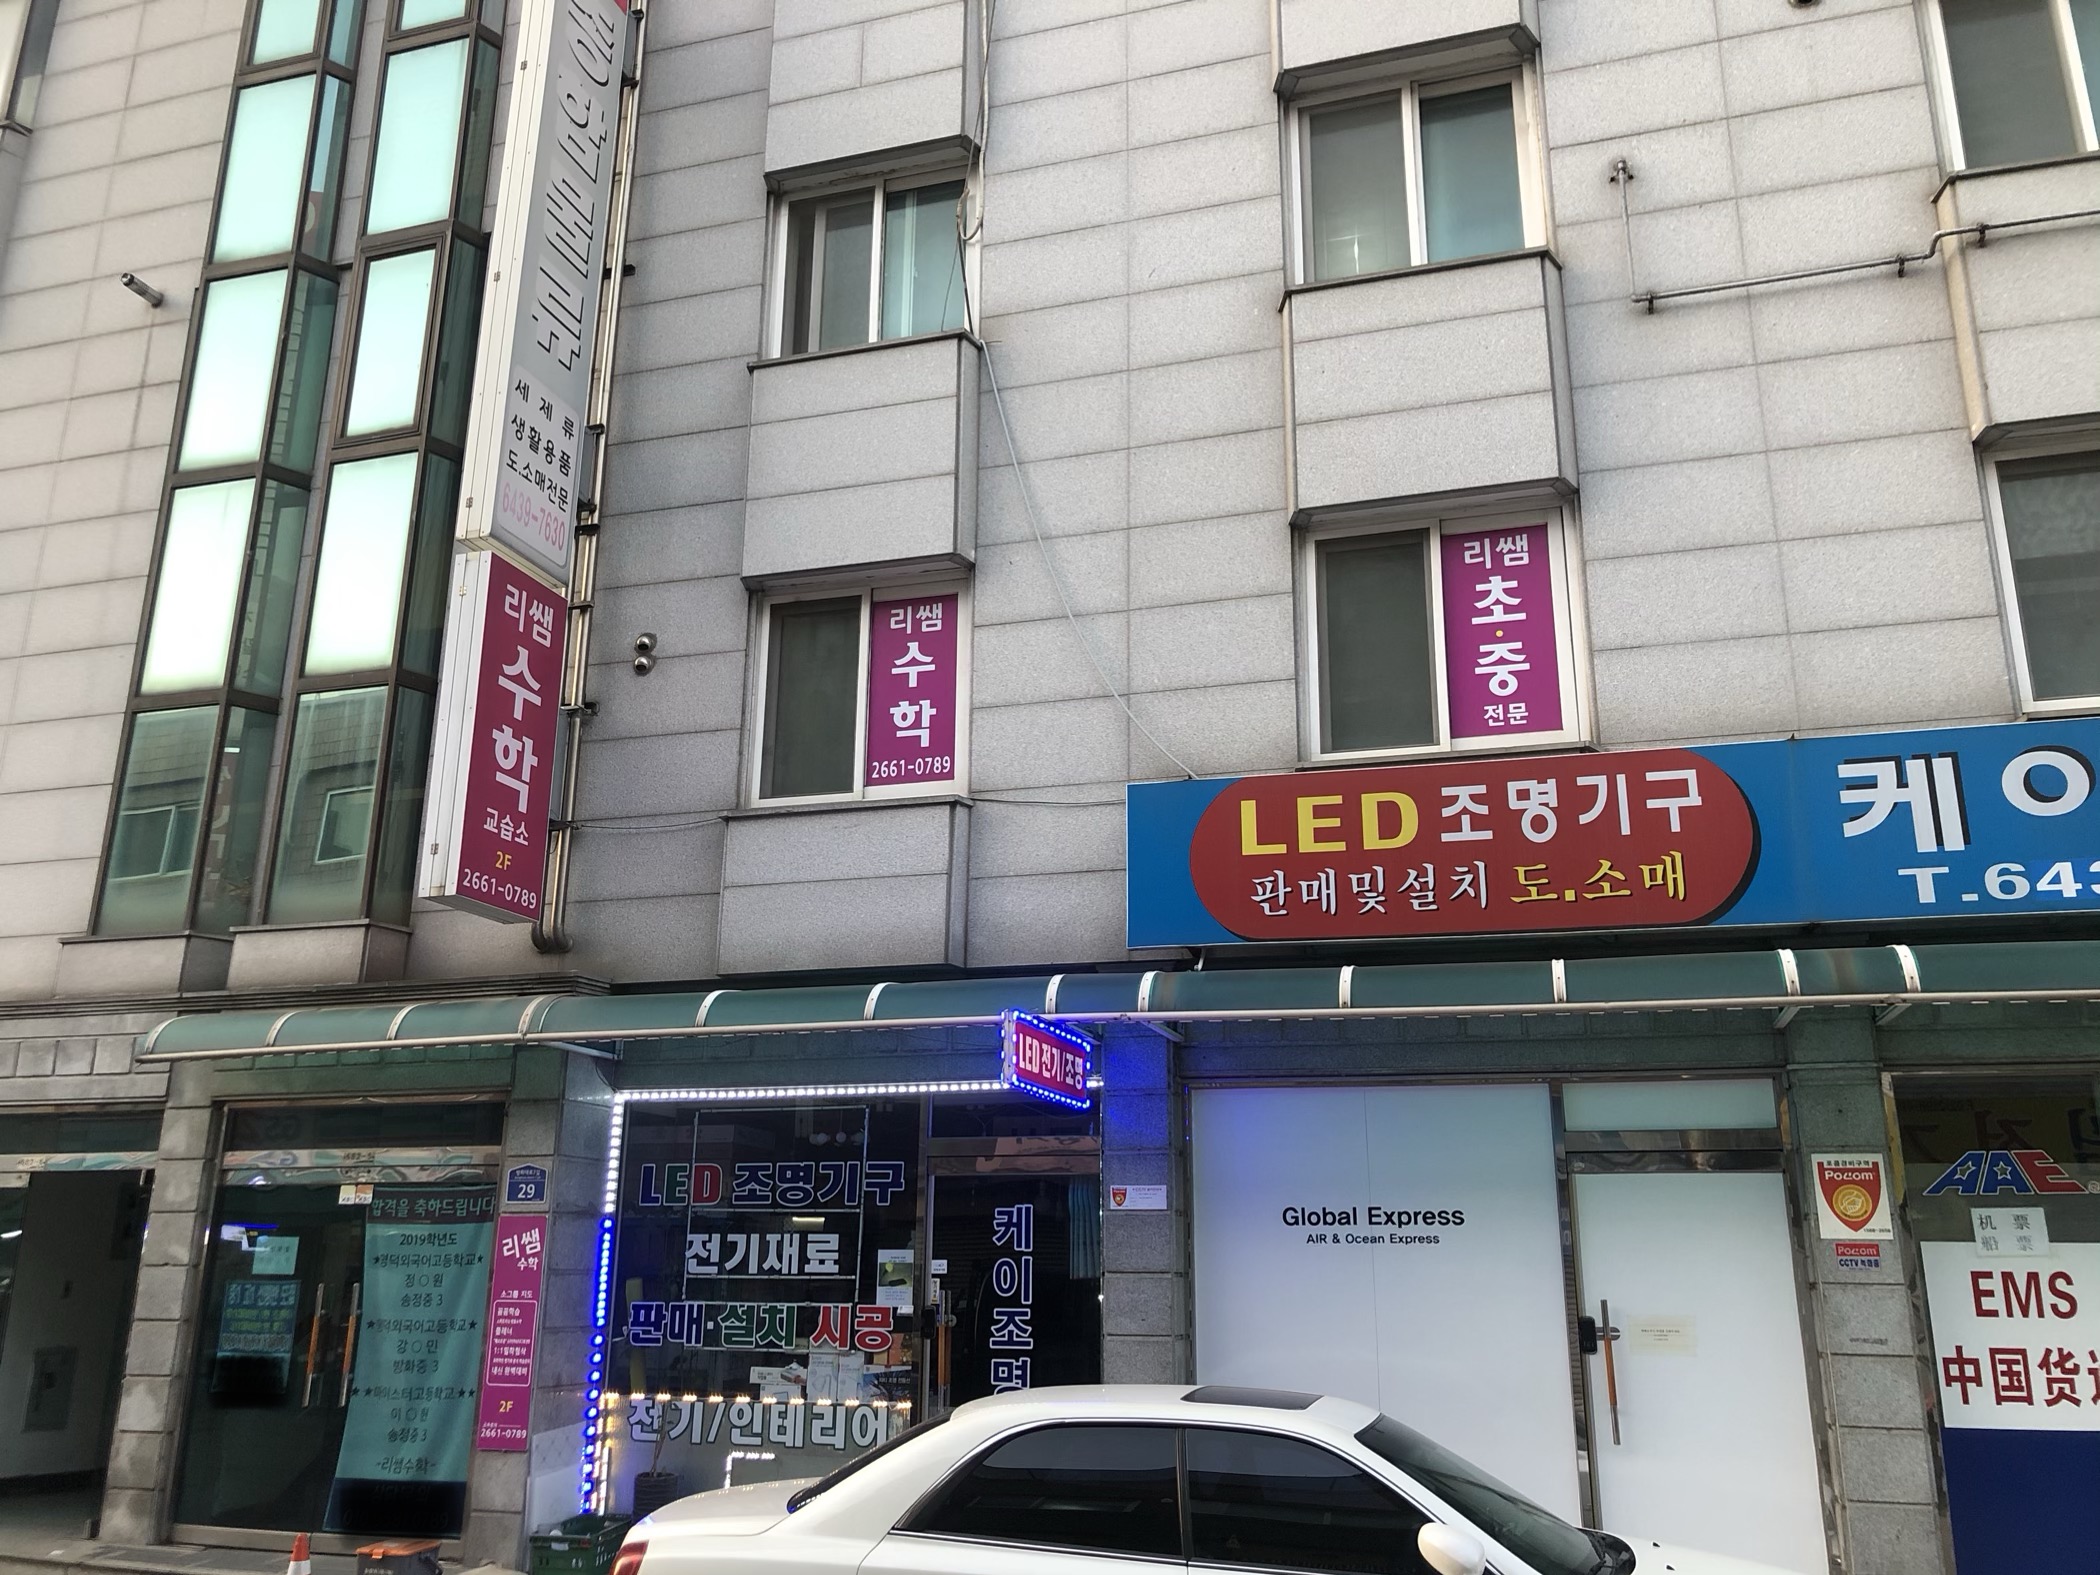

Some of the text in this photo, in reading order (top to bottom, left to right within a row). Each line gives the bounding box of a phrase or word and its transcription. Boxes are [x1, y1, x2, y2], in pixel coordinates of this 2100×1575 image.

[511, 414, 572, 477] 생활용품
[502, 482, 565, 551] 6439-7630
[1464, 534, 1530, 569] 리쌤
[504, 583, 554, 648] 리쌤
[890, 603, 943, 634] 리쌤
[889, 642, 937, 748] 수학
[1484, 702, 1529, 727] 전문
[492, 645, 542, 813] 수학
[872, 756, 951, 778] 2661-0789
[483, 808, 529, 846] 교습소
[1241, 769, 1702, 856] LED 조명기구
[495, 851, 512, 870] 2F
[1510, 850, 1686, 903] 도.소매
[462, 868, 537, 909] 2661-0789
[1019, 1032, 1083, 1090] LED 전기/조명
[517, 1184, 535, 1199] 29
[639, 1161, 905, 1206] LED 조명기구
[1923, 1150, 2089, 1195] AAE
[372, 1196, 496, 1218] 합격을 축하드립니다
[1282, 1206, 1465, 1228] Global Express
[400, 1233, 458, 1247] 2019학년도
[502, 1228, 541, 1259] 리쌤
[685, 1233, 840, 1275] 전기재료
[1306, 1234, 1440, 1245] AIR & Ocean Express
[517, 1257, 539, 1271] 수학
[1839, 1258, 1859, 1267] CCTV
[989, 1204, 1033, 1396] 케이조명
[1970, 1271, 2078, 1319] EMS
[810, 1304, 894, 1352] 시공
[499, 1400, 513, 1413] 2F
[628, 1398, 888, 1450] 전기/인테리어
[480, 1428, 527, 1439] 2661-0789
